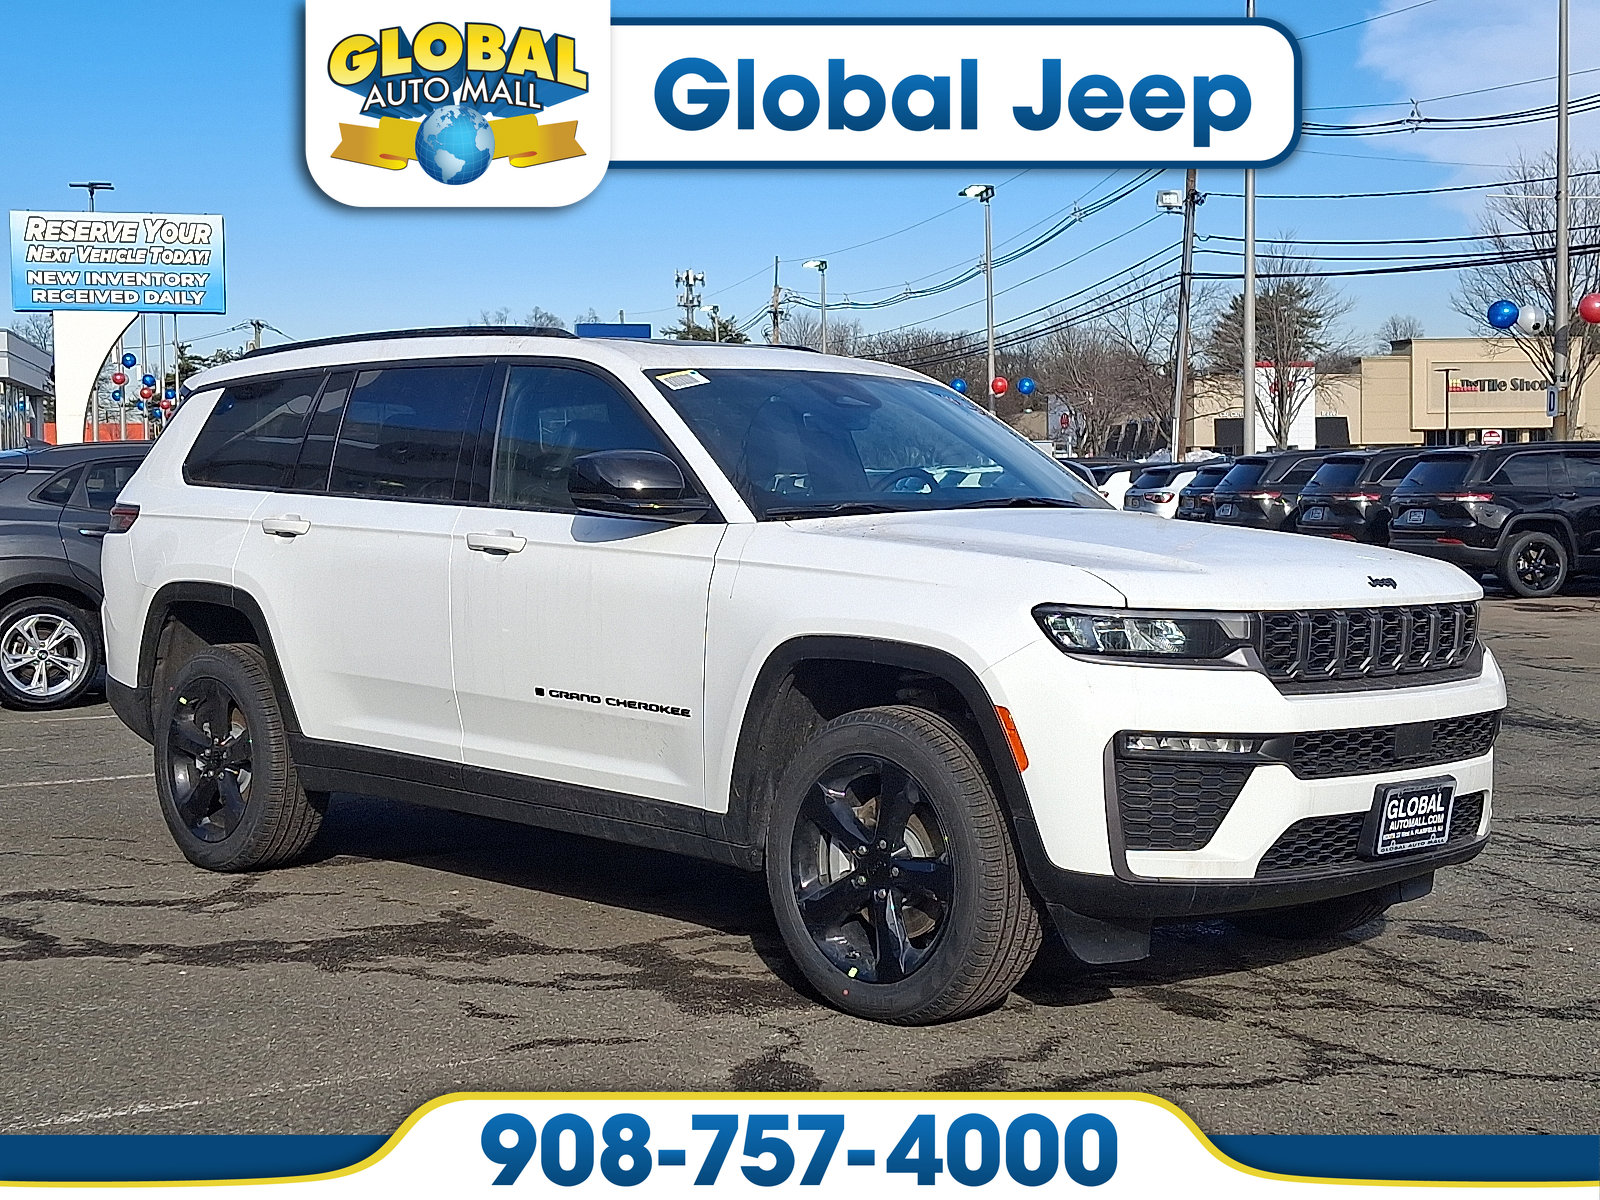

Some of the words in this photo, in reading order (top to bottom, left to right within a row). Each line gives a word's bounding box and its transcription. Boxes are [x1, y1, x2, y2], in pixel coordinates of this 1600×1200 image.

[24, 216, 139, 243] RESERVE
[143, 218, 212, 244] YOUR
[26, 245, 75, 263] NEXT
[77, 245, 148, 264] VEHICLE
[27, 270, 81, 285] NEW
[85, 271, 210, 287] INVENTORY
[32, 288, 139, 304] RECEIVED
[144, 290, 206, 305] DAILY
[1478, 379, 1507, 391] Tile
[1367, 576, 1397, 589] Jeep
[549, 689, 601, 704] GRAND
[605, 697, 691, 718] CHEROKEE
[1387, 793, 1444, 819] GLOBAL
[1381, 844, 1406, 852] GLOBAL
